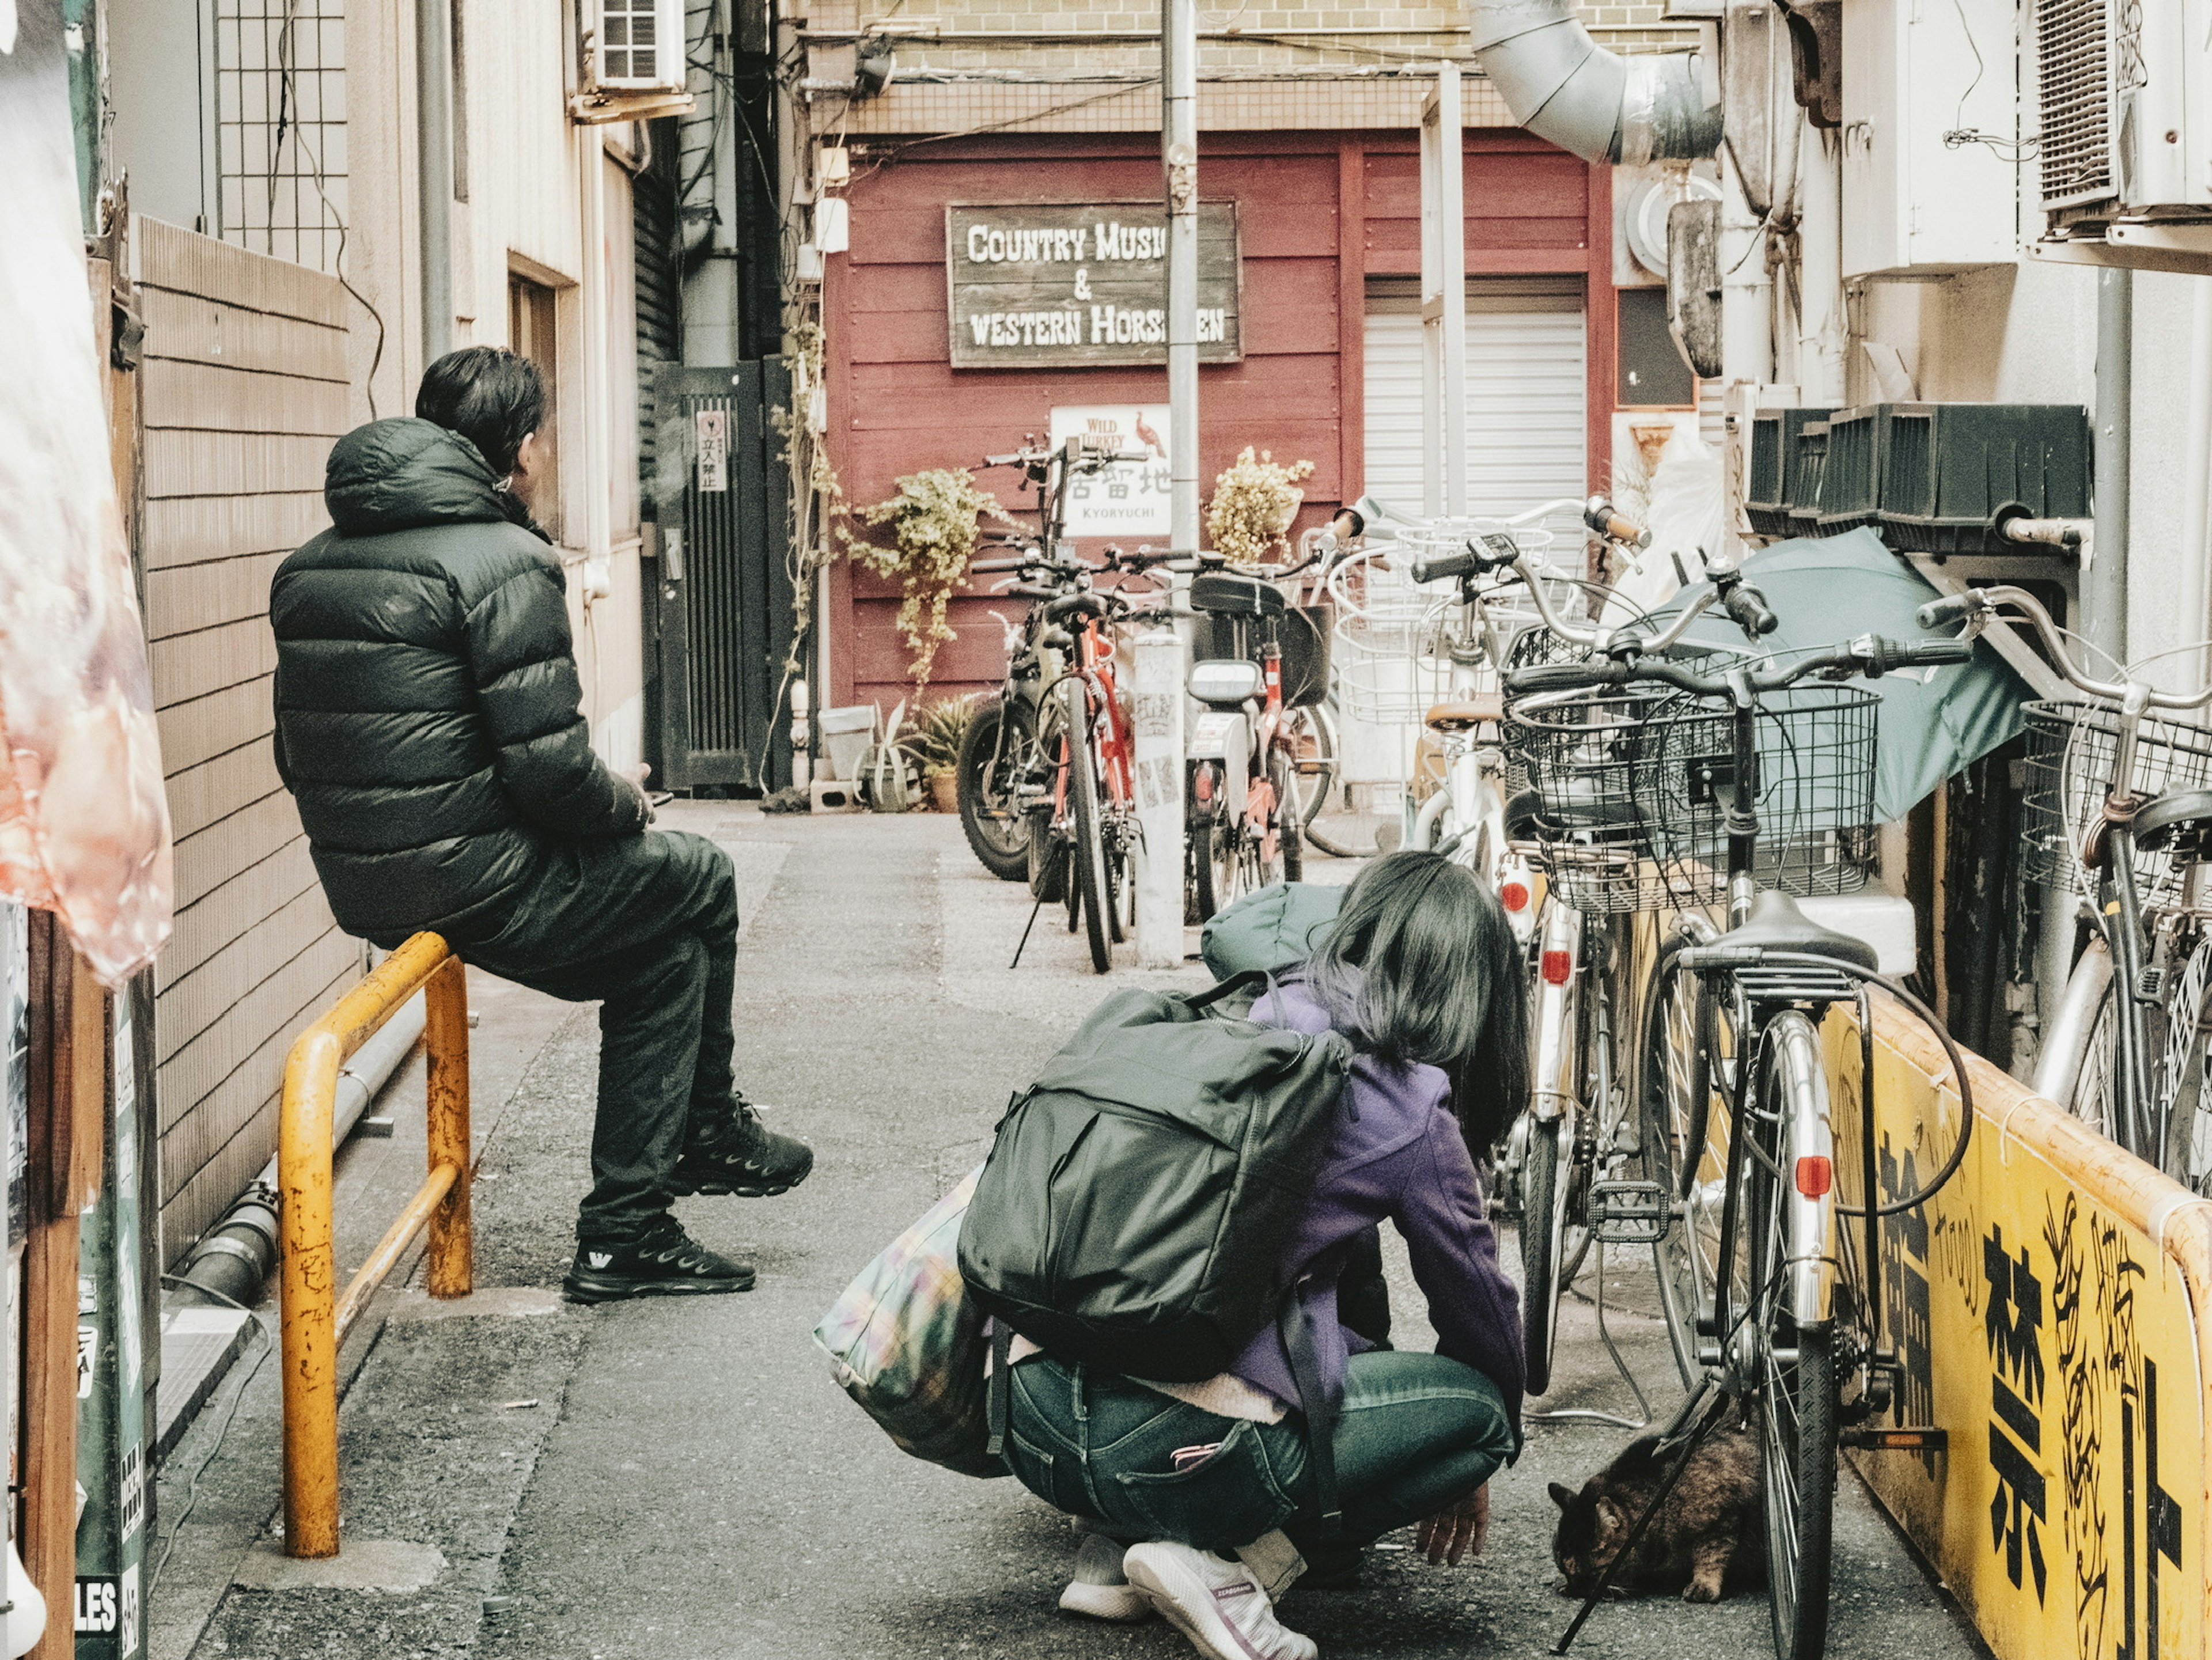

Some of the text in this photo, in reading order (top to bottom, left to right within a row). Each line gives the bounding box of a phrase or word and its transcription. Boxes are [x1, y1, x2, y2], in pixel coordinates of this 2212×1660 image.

[968, 222, 1166, 263] COUNTRY MUSI
[1074, 268, 1092, 301] &
[971, 304, 1225, 346] WESTERN HORSEN
[1086, 418, 1118, 433] WILD
[702, 439, 717, 488] 立入禁止
[1082, 507, 1155, 519] KYORYUCHI
